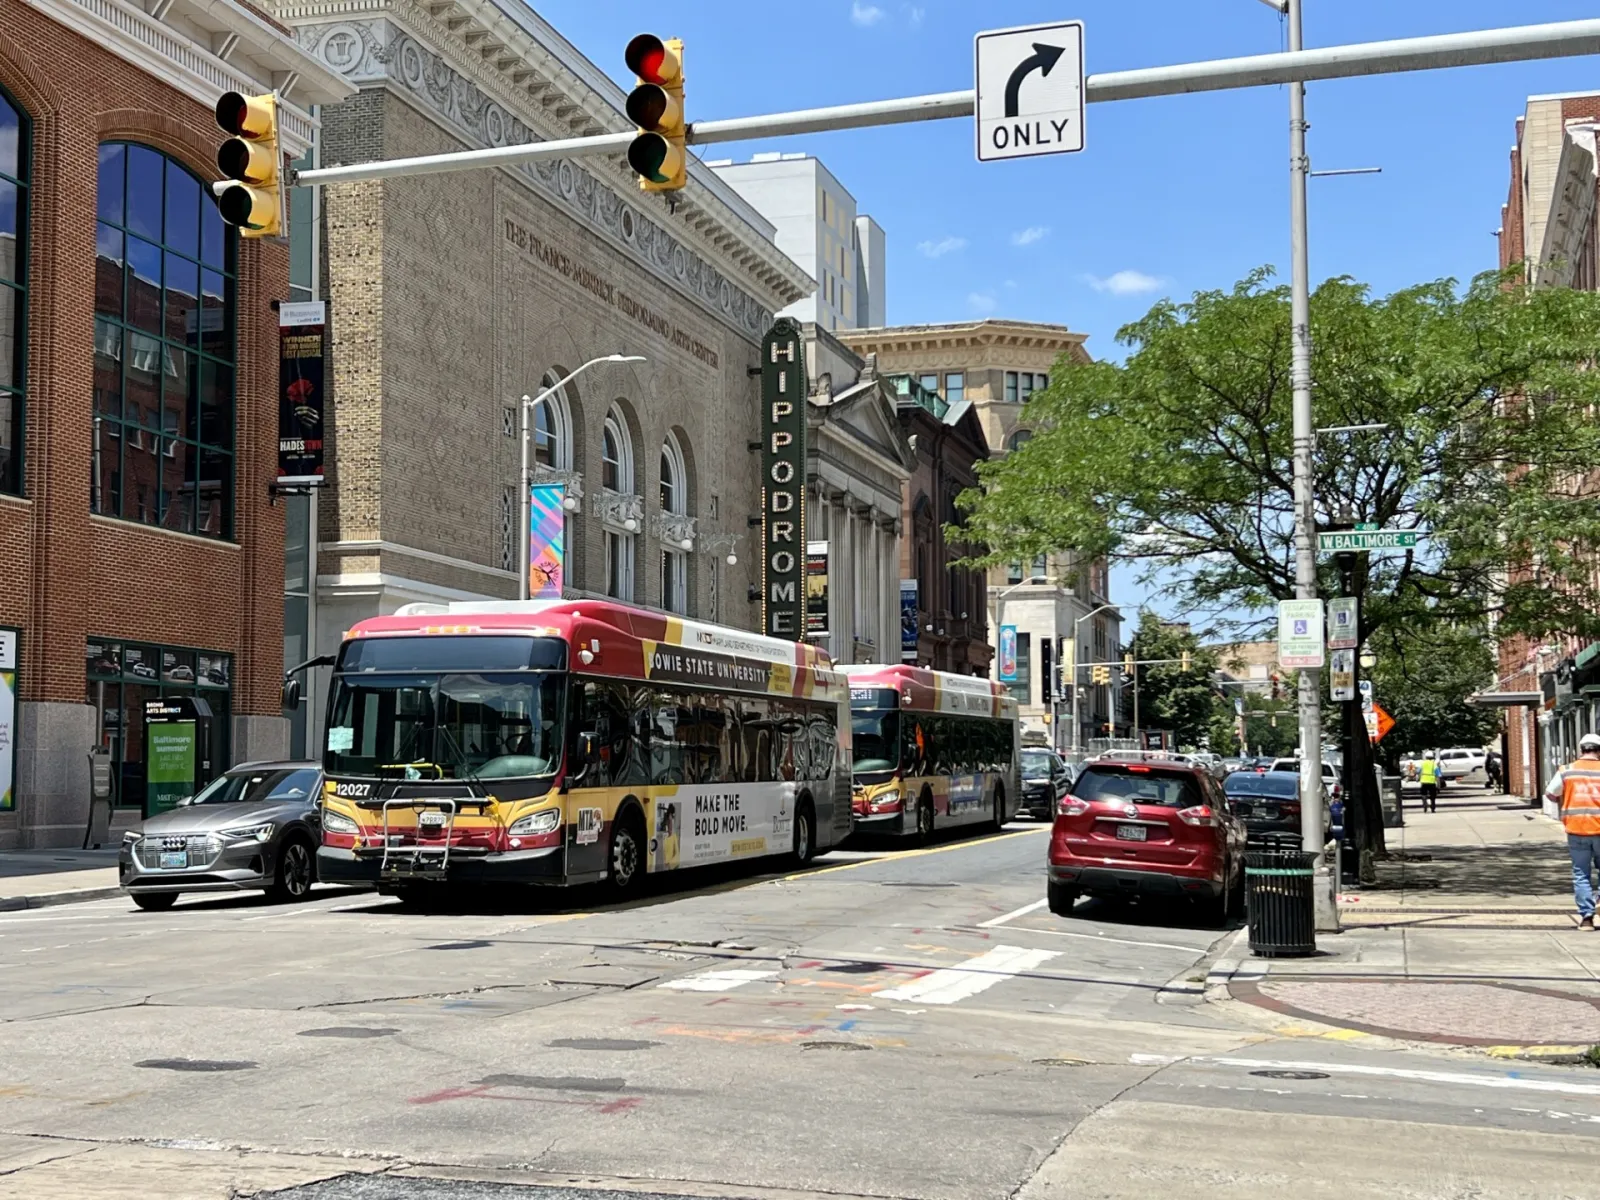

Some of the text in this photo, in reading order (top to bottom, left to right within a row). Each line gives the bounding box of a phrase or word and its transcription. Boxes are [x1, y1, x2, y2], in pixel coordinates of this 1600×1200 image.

[993, 118, 1069, 149] ONLY
[504, 218, 526, 249] THE
[770, 341, 796, 634] HIPPODROME
[1335, 533, 1401, 548] BALTIMORE
[649, 651, 682, 673] BOWIE
[686, 657, 714, 677] STATE
[717, 662, 767, 683] UNIVERSITY
[153, 735, 191, 744] Baltimore
[336, 784, 370, 796] 12027
[695, 794, 740, 814] MAKE THE
[579, 809, 594, 831] MTA
[695, 815, 748, 836] BOLD MOVE.
